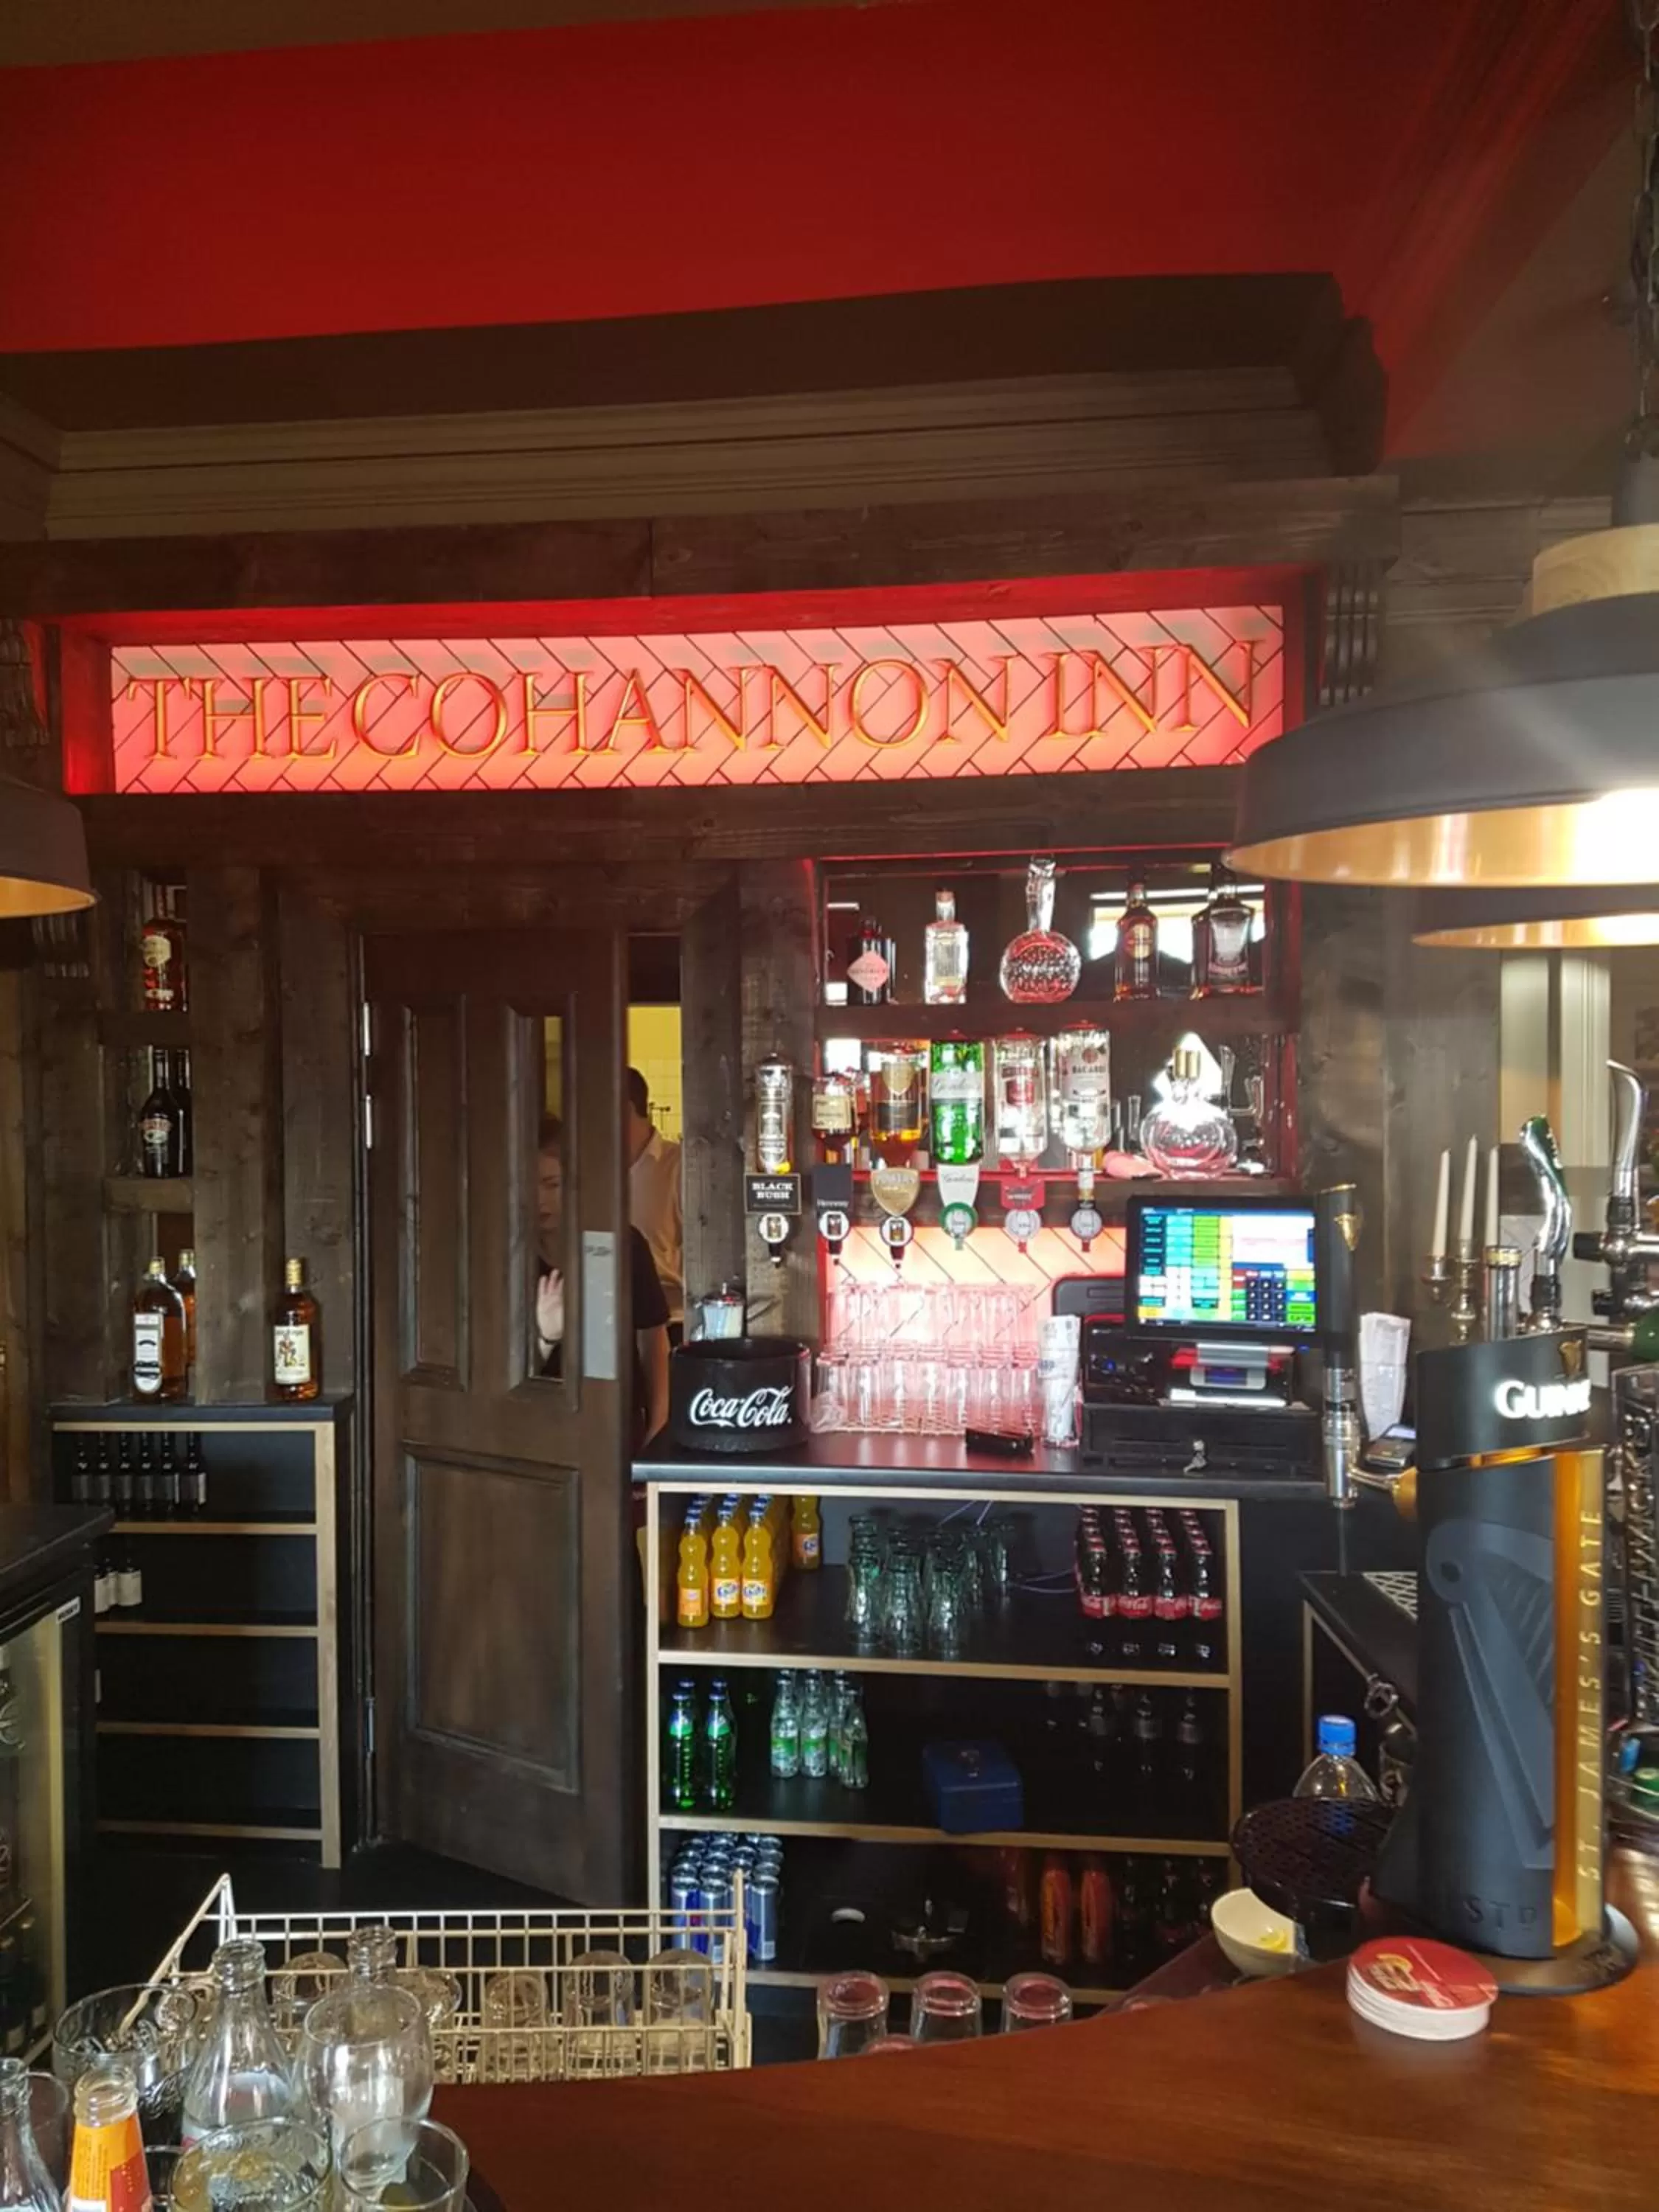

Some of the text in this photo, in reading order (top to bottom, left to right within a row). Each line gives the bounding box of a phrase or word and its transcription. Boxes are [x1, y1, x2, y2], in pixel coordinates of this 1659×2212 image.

[127, 639, 1265, 762] THE COHANNON INN
[751, 1182, 793, 1191] BLACK
[756, 1191, 790, 1200] BUSH
[689, 1385, 793, 1427] Coca-Cola
[1579, 1510, 1602, 1607] GATE
[1577, 1630, 1601, 1801] JAMES'S
